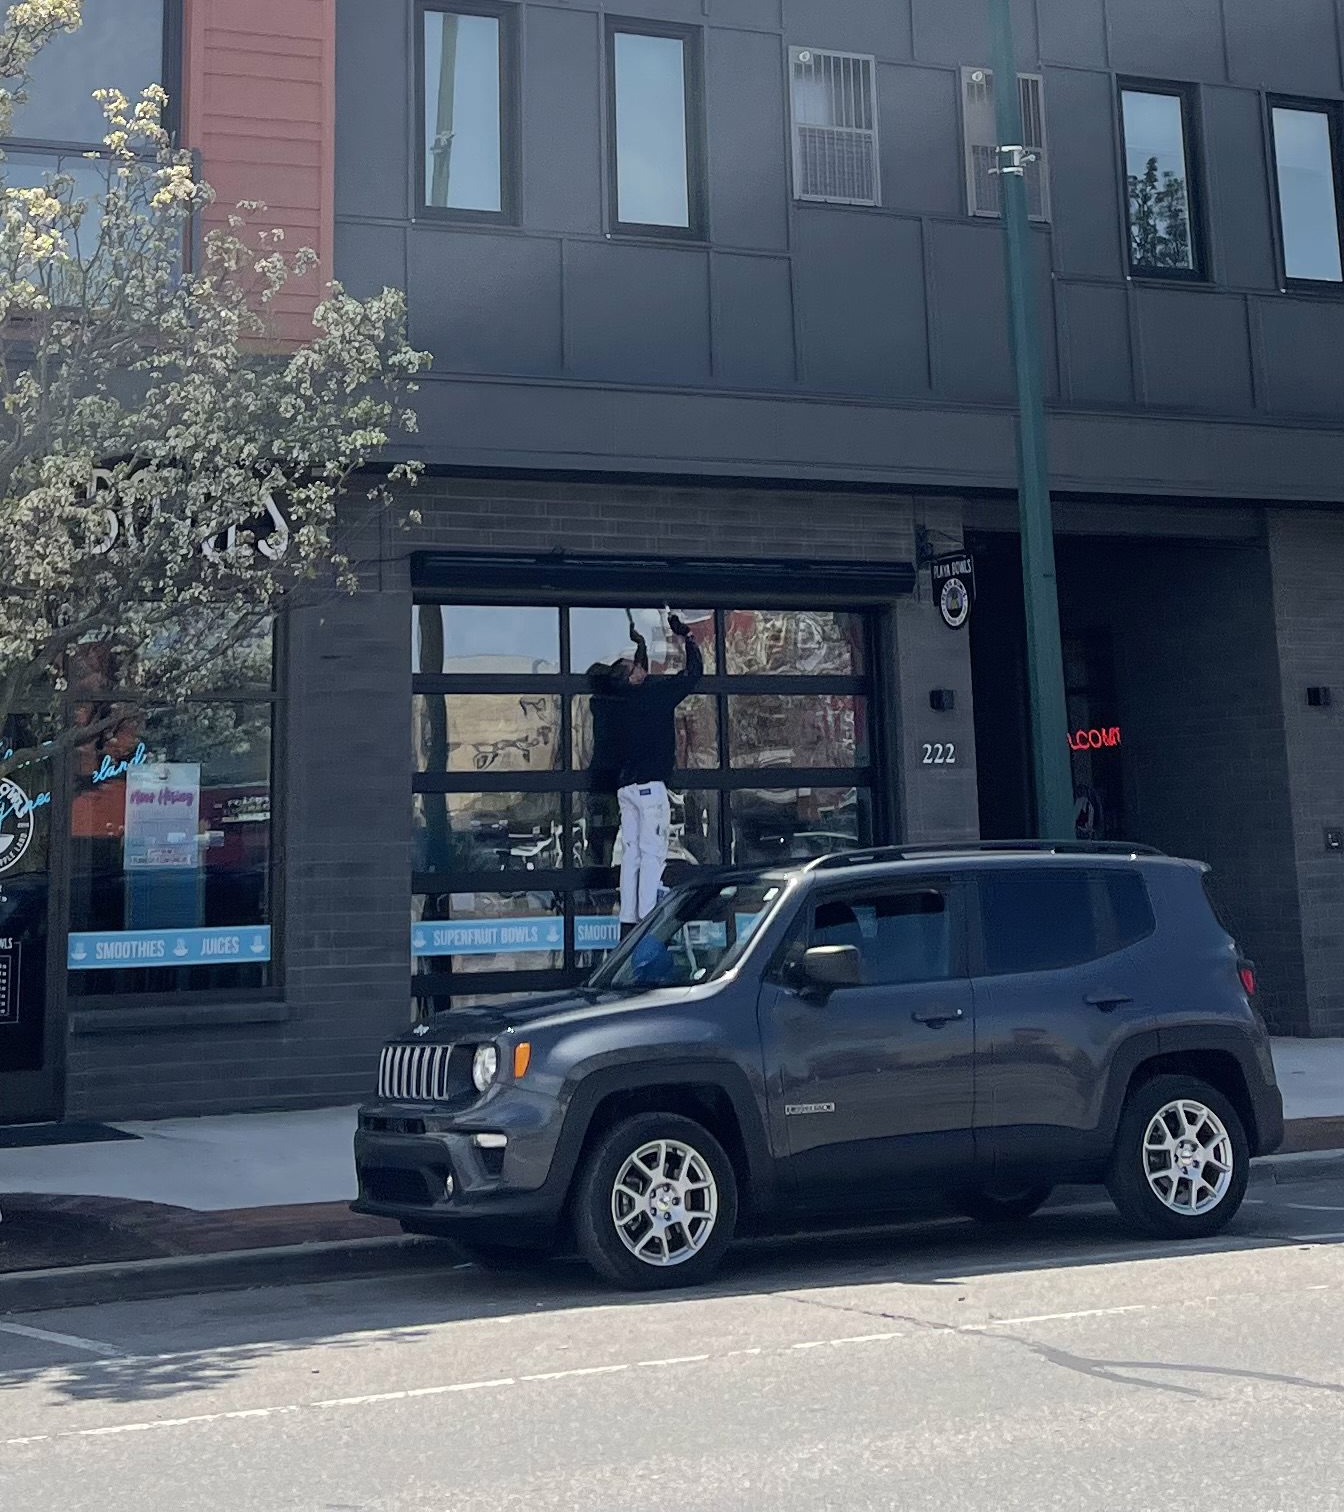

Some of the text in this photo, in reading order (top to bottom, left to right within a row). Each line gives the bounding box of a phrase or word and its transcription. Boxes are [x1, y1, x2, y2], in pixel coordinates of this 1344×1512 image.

[922, 743, 956, 764] 222
[433, 929, 499, 947] SUPERFRUIT
[501, 925, 539, 944] BOWLS
[95, 936, 240, 960] SMOOTHIES JUICES
